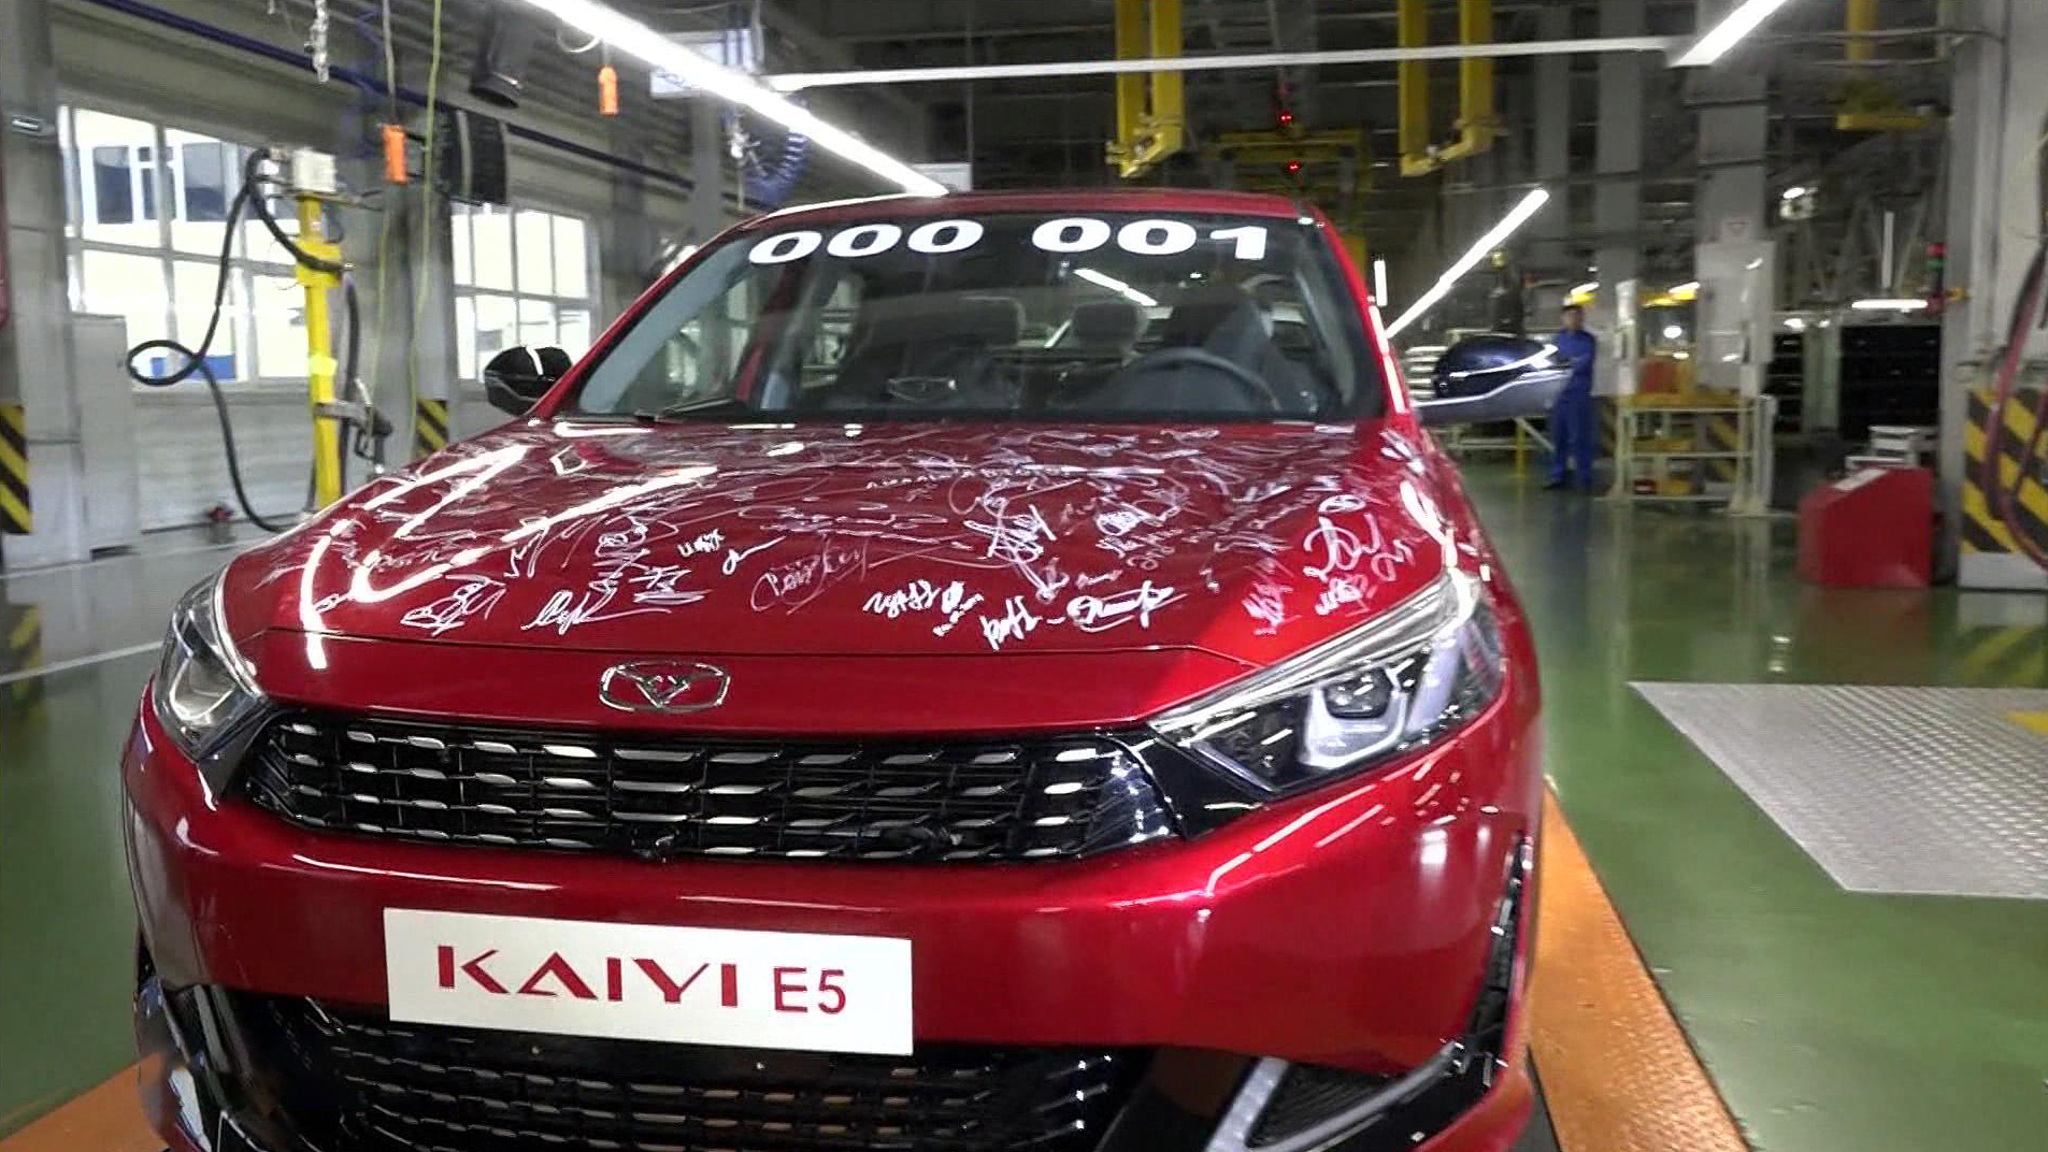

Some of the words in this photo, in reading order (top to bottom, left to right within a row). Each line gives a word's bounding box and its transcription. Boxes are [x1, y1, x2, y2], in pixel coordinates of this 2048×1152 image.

[749, 219, 984, 264] 000
[1032, 218, 1268, 261] 001
[437, 945, 738, 1008] KAIYI
[773, 966, 847, 1014] E5
